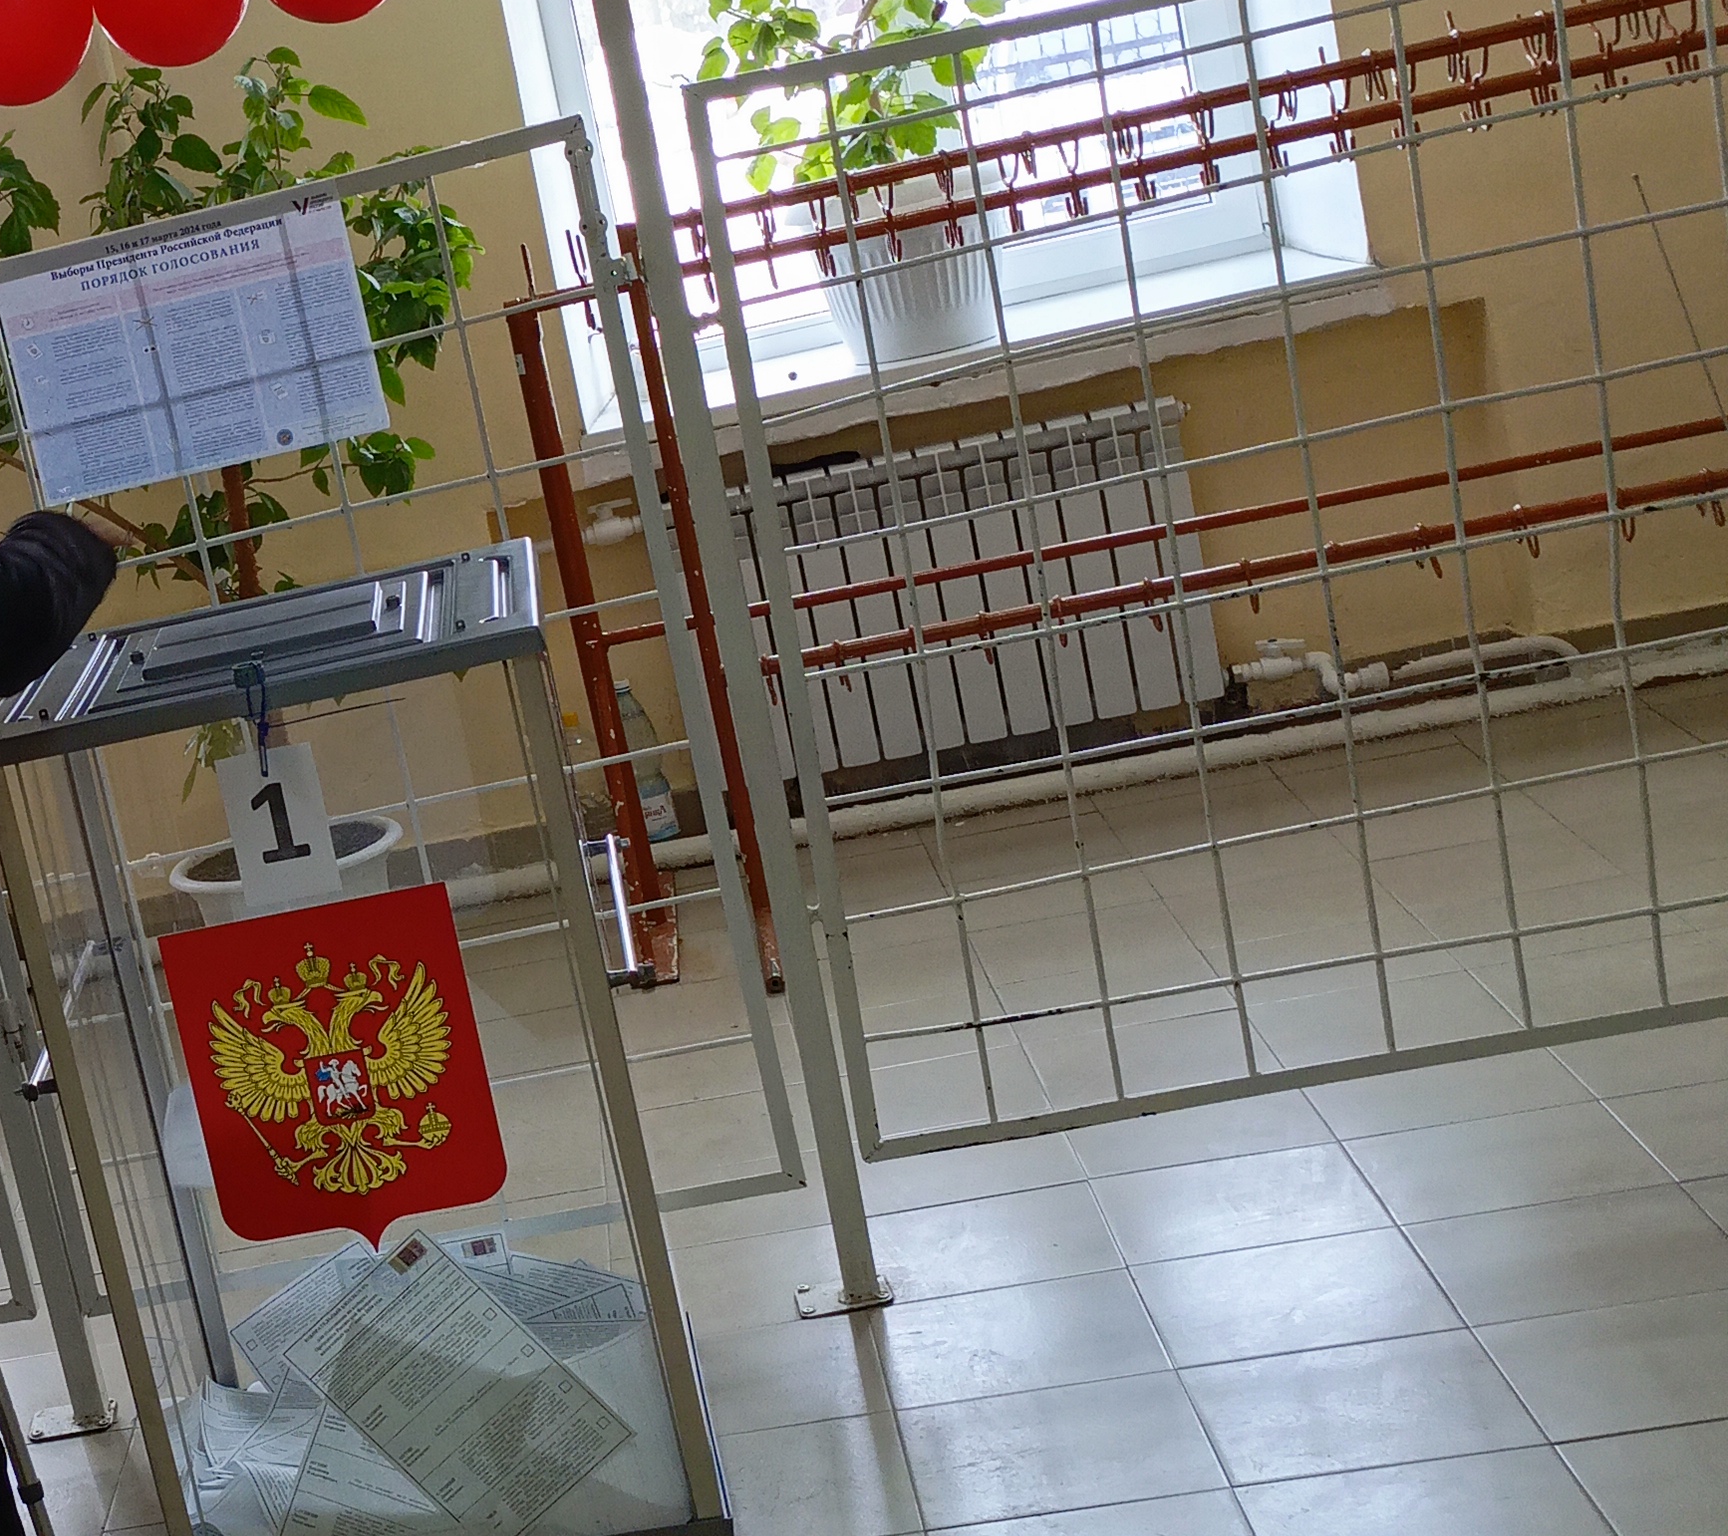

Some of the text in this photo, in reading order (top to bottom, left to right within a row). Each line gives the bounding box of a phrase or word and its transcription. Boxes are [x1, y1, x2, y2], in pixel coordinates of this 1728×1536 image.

[50, 217, 283, 281] Выборы Президента Российской Федерации
[80, 266, 149, 292] ПОРЯДОК
[151, 239, 261, 275] ГОЛОСОВАНИЯ
[104, 220, 222, 255] 15, 16 и 17 марта 2024 года
[250, 781, 312, 865] 1
